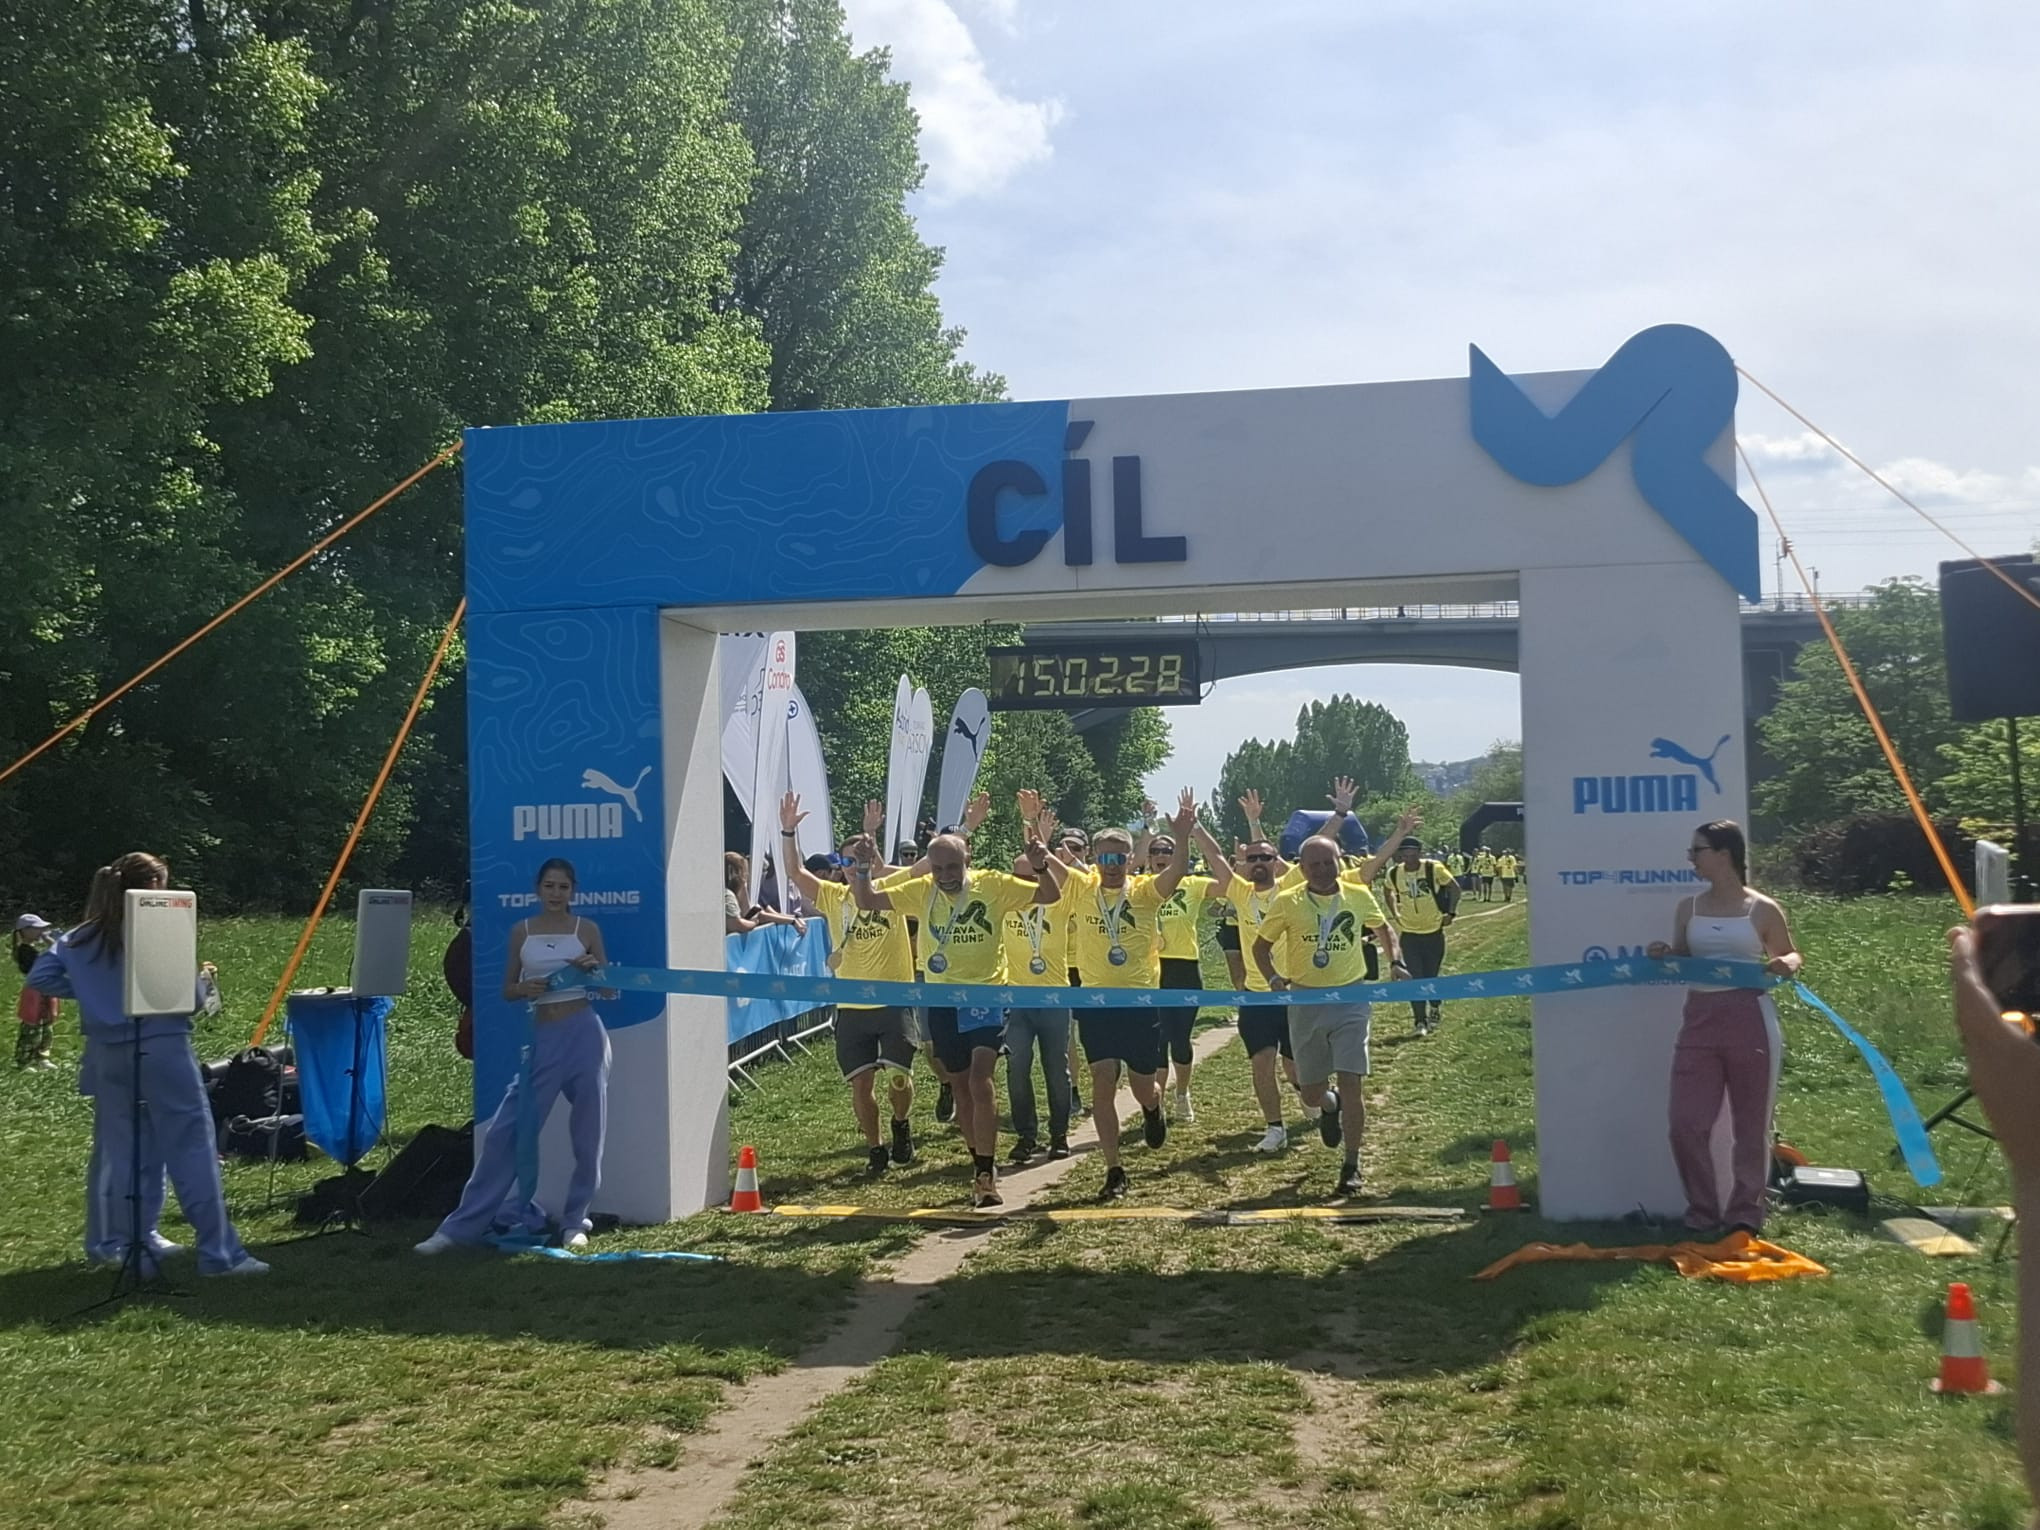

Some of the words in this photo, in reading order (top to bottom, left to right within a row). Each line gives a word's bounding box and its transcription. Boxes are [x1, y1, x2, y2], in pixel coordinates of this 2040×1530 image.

[967, 420, 1187, 567] CÍL
[1573, 774, 1698, 814] PUMA
[513, 802, 623, 841] PUMA
